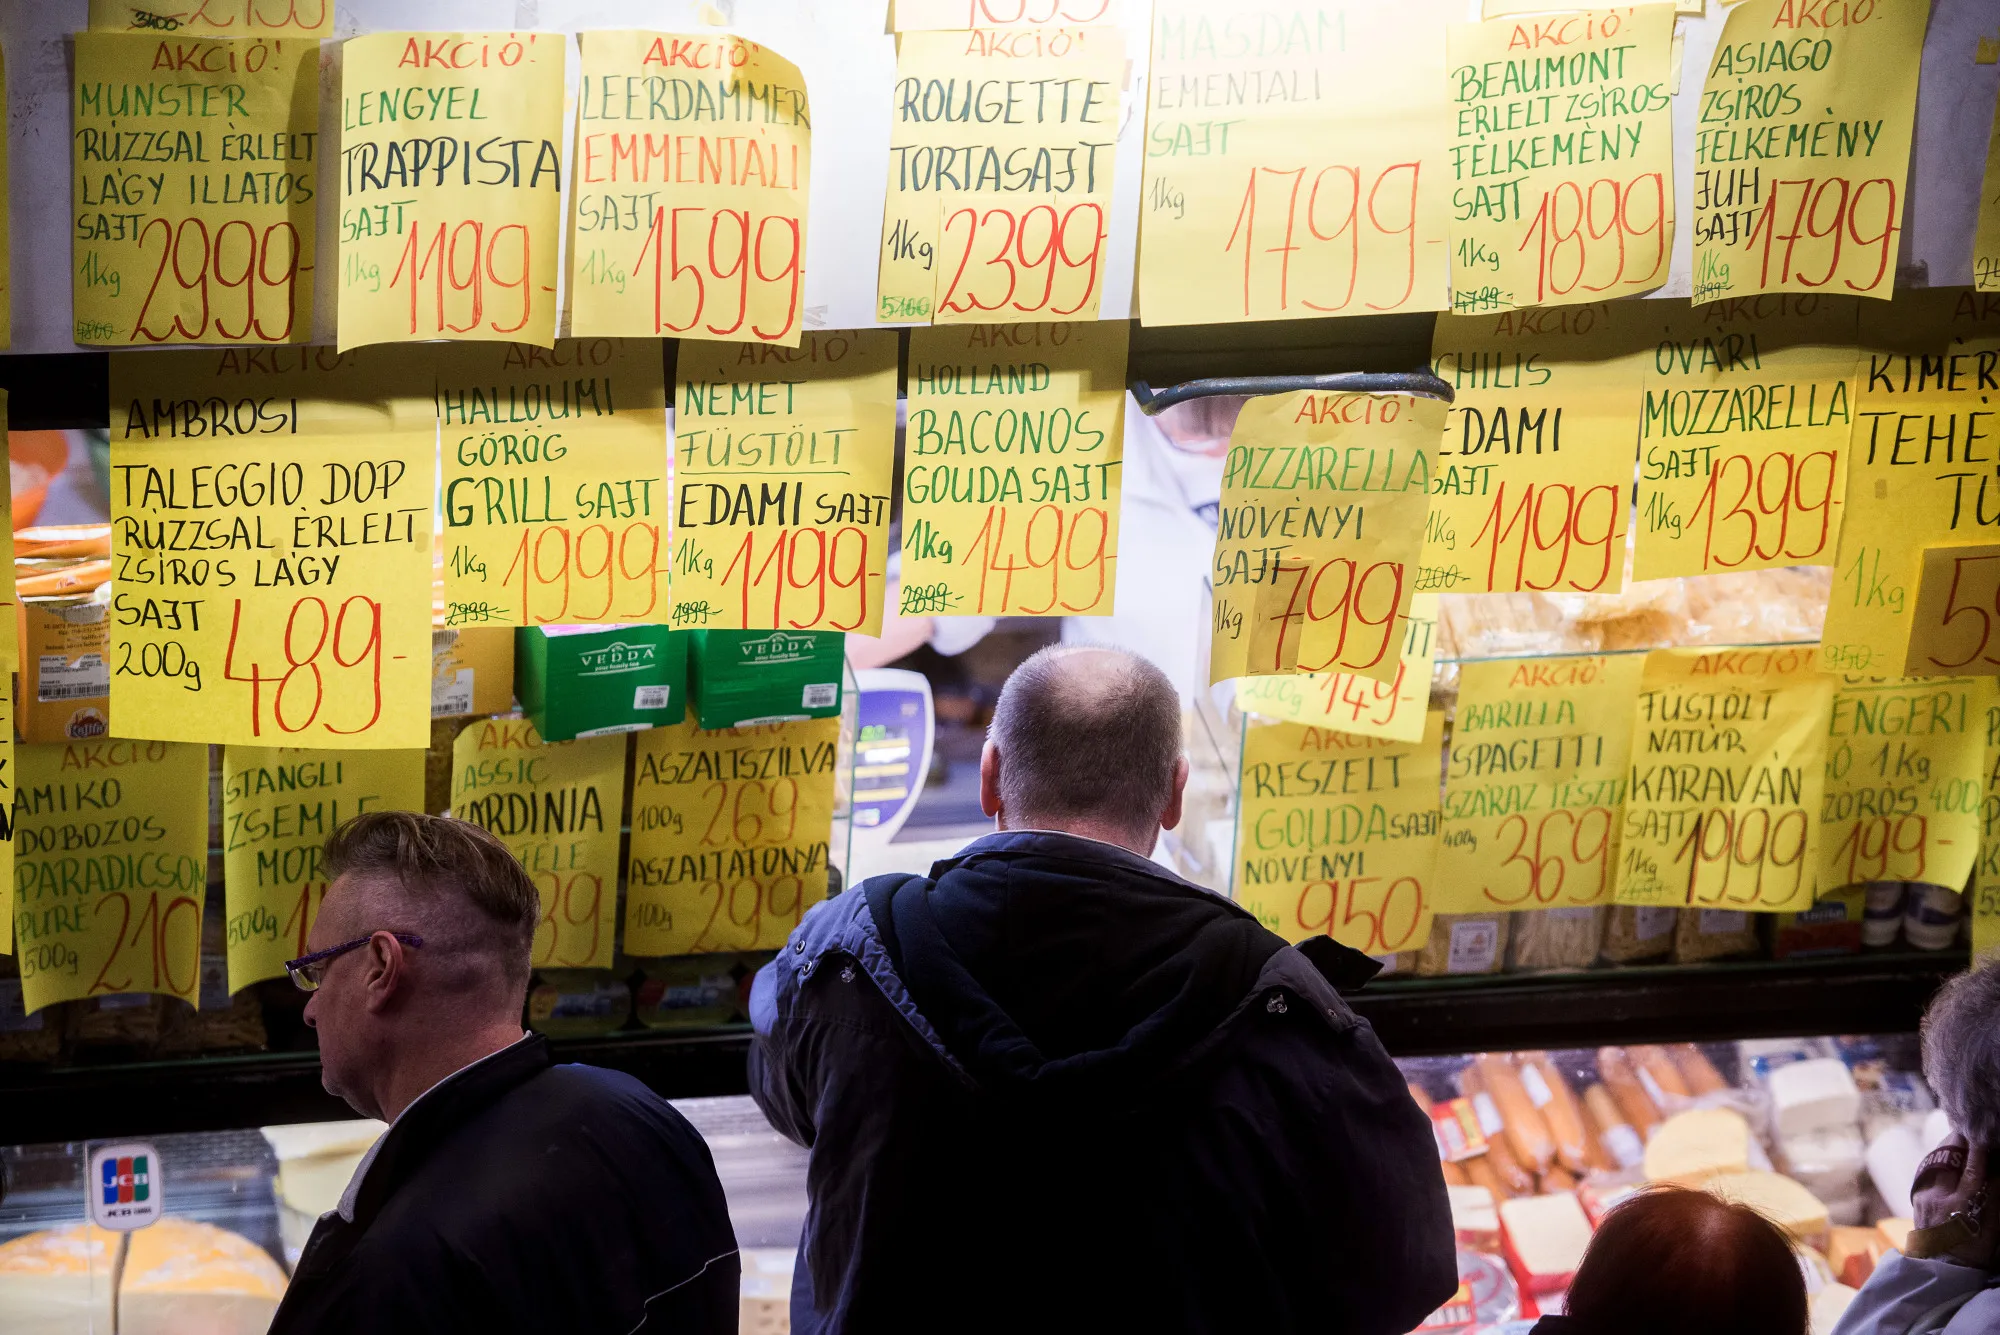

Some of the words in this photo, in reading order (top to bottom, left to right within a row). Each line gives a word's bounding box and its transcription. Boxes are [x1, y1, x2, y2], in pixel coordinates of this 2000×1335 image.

[1160, 9, 1347, 60] MASDAM
[1451, 45, 1637, 103] BEAUMONT
[1711, 38, 1832, 79] ASIAGO
[81, 82, 249, 117] MUNSTER
[345, 87, 488, 132] LENGYEL
[583, 75, 811, 130] LEERDAMMER
[895, 77, 1110, 124] ROUGETTE
[1157, 68, 1322, 109] EMENTALI
[1148, 119, 1247, 158] SAJT
[342, 136, 561, 196] TRAPPISTA
[890, 141, 1114, 193] TORTASAJT
[190, 172, 314, 205] ILLATOS
[1453, 176, 1530, 222] SAJT
[77, 213, 146, 241] SAJT
[341, 199, 418, 243] SAJT
[578, 191, 661, 231] SAJT
[1695, 207, 1763, 246] SAJT
[917, 362, 1050, 395] HOLLAND
[1435, 352, 1551, 390] CHILIS
[125, 397, 298, 439] AMBROSI
[444, 377, 615, 426] HALLOUMI
[1645, 380, 1850, 438] MOZZARELLA
[457, 424, 568, 467] GÖRÖG
[676, 424, 859, 467] FÜSTÖLT
[909, 407, 1105, 456] BACONOS
[1225, 446, 1429, 494] PIZZARELLA
[1644, 445, 1720, 480] SAJT
[113, 462, 304, 510] TALEGGIO
[319, 460, 406, 505] DOP
[446, 475, 568, 527] GRILL
[575, 478, 660, 519] SAJT
[678, 481, 803, 528] EDAMI
[814, 492, 891, 527] SAJT
[1215, 544, 1293, 587] SAJT
[114, 593, 205, 631] SAJT
[116, 641, 202, 692] 200g
[581, 650, 654, 666] VEDDA
[741, 640, 816, 656] VEDDA
[1461, 700, 1575, 732] BARILLA
[1639, 684, 1782, 723] FÜSTÖLT
[1243, 753, 1410, 798] RESZELT
[1452, 733, 1602, 778] SPAGETTI
[14, 777, 122, 817] AMIKO
[226, 760, 342, 806] STANGLI
[16, 815, 166, 857] DOBOZOS
[637, 804, 683, 834] 100g
[1256, 804, 1387, 850] GOUDA
[1484, 806, 1612, 905] 369
[1675, 808, 1808, 906] 1999
[229, 905, 278, 947] 500g
[23, 942, 79, 979] 500g
[103, 1173, 148, 1188] JCB
